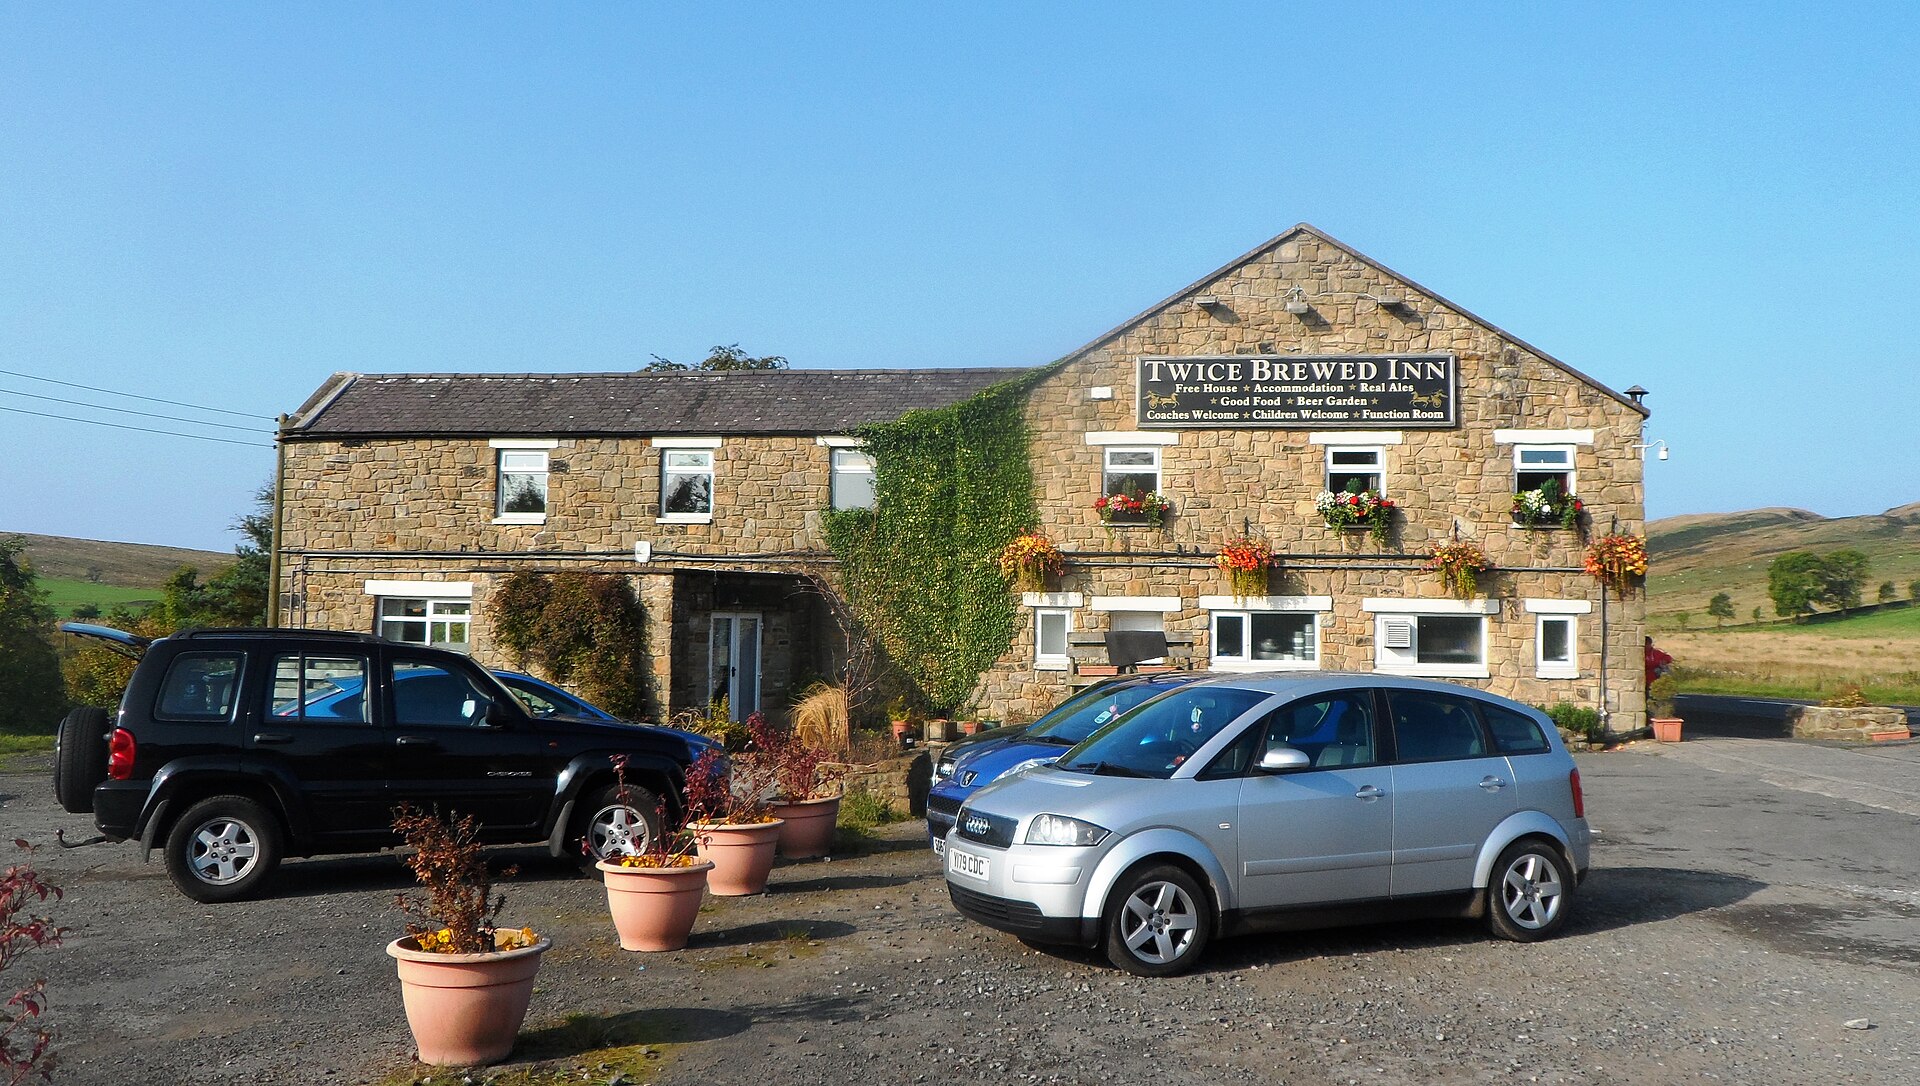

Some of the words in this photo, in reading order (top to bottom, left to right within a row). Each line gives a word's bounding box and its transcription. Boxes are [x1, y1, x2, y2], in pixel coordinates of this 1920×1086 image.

[1145, 360, 1243, 382] TWICE
[1250, 359, 1378, 381] BREWED
[1387, 359, 1446, 380] INN
[1175, 383, 1200, 393] Free
[1203, 383, 1238, 393] House
[1253, 383, 1344, 393] Accommodation
[1360, 382, 1385, 392] Real
[1389, 382, 1414, 392] Ales
[1220, 396, 1250, 406] Good
[1253, 396, 1281, 406] Food
[1297, 396, 1323, 406] Beer
[1326, 396, 1367, 406] Garden
[1146, 410, 1190, 420] Coaches
[1192, 410, 1240, 420] Welcome
[1252, 409, 1298, 419] Children
[1300, 409, 1349, 419] Welcome
[1362, 409, 1411, 419] Function
[1413, 409, 1444, 419] Room
[968, 856, 984, 876] CDC
